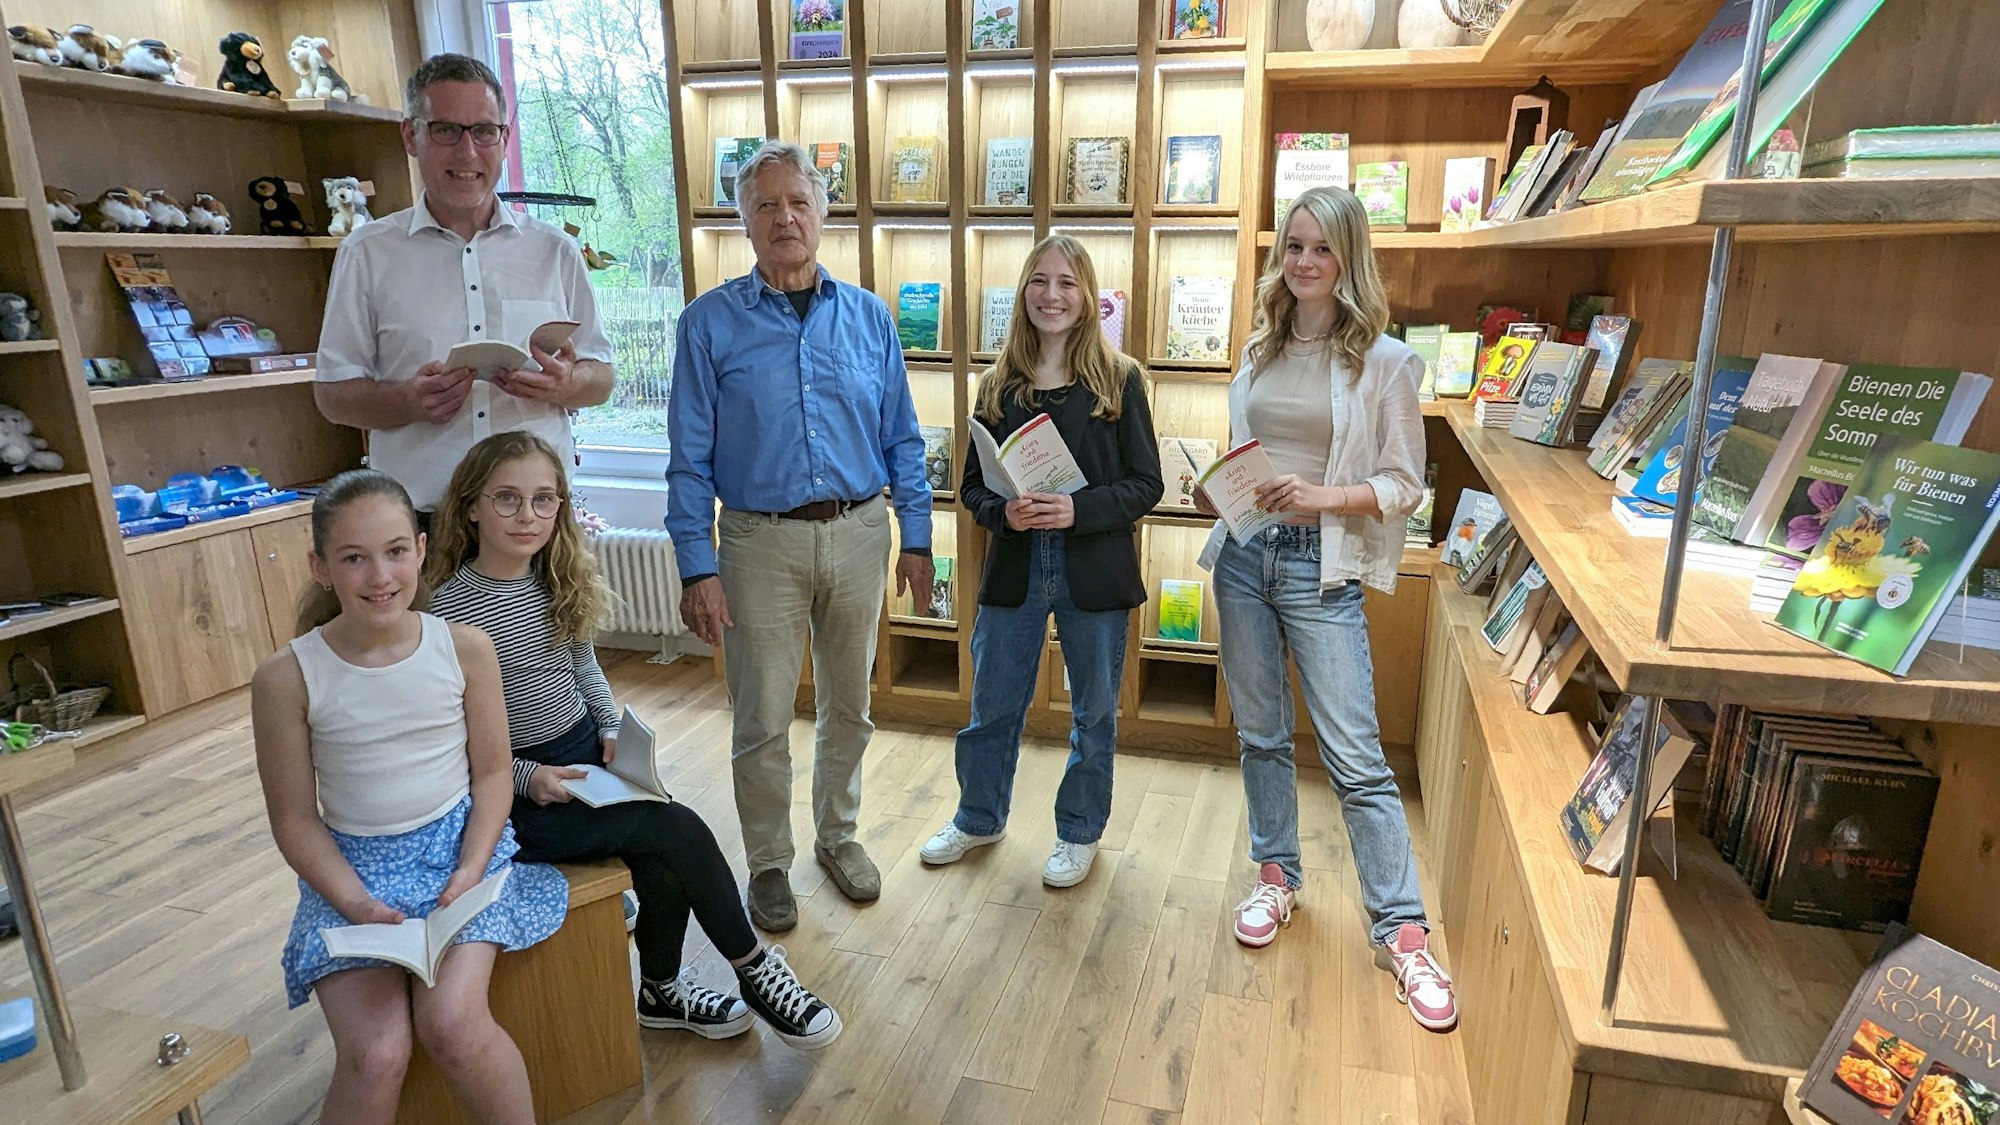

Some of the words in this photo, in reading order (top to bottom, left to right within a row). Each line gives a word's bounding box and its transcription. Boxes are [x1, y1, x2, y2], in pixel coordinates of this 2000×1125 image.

[991, 160, 1024, 168] RUNGEN
[1295, 162, 1331, 171] Essbare
[991, 169, 1006, 179] FÜR
[1011, 170, 1025, 179] DIE
[1284, 172, 1343, 181] Wildpflanzen
[1178, 303, 1224, 314] Kräuter
[991, 316, 1005, 326] FÜR
[1182, 315, 1217, 325] küche
[1480, 381, 1502, 393] Pilze
[1757, 371, 1805, 393] Tagebuch
[1848, 375, 1913, 398] Bienen
[1915, 380, 1946, 400] Die
[1719, 391, 1737, 402] Dem
[1708, 402, 1722, 411] auf
[1722, 404, 1738, 413] der
[1836, 400, 1889, 422] Seele
[1891, 404, 1924, 426] des
[1026, 448, 1037, 458] und
[1809, 465, 1845, 479] Marzellus
[1895, 457, 1920, 475] Wir
[1921, 466, 1945, 481] tun
[1949, 473, 1978, 488] was
[1232, 473, 1244, 485] und
[1893, 476, 1917, 492] für
[1916, 481, 1967, 505] Bienen
[1472, 507, 1497, 521] füttern
[1701, 497, 1726, 517] Marzellus
[1724, 507, 1738, 522] Boos
